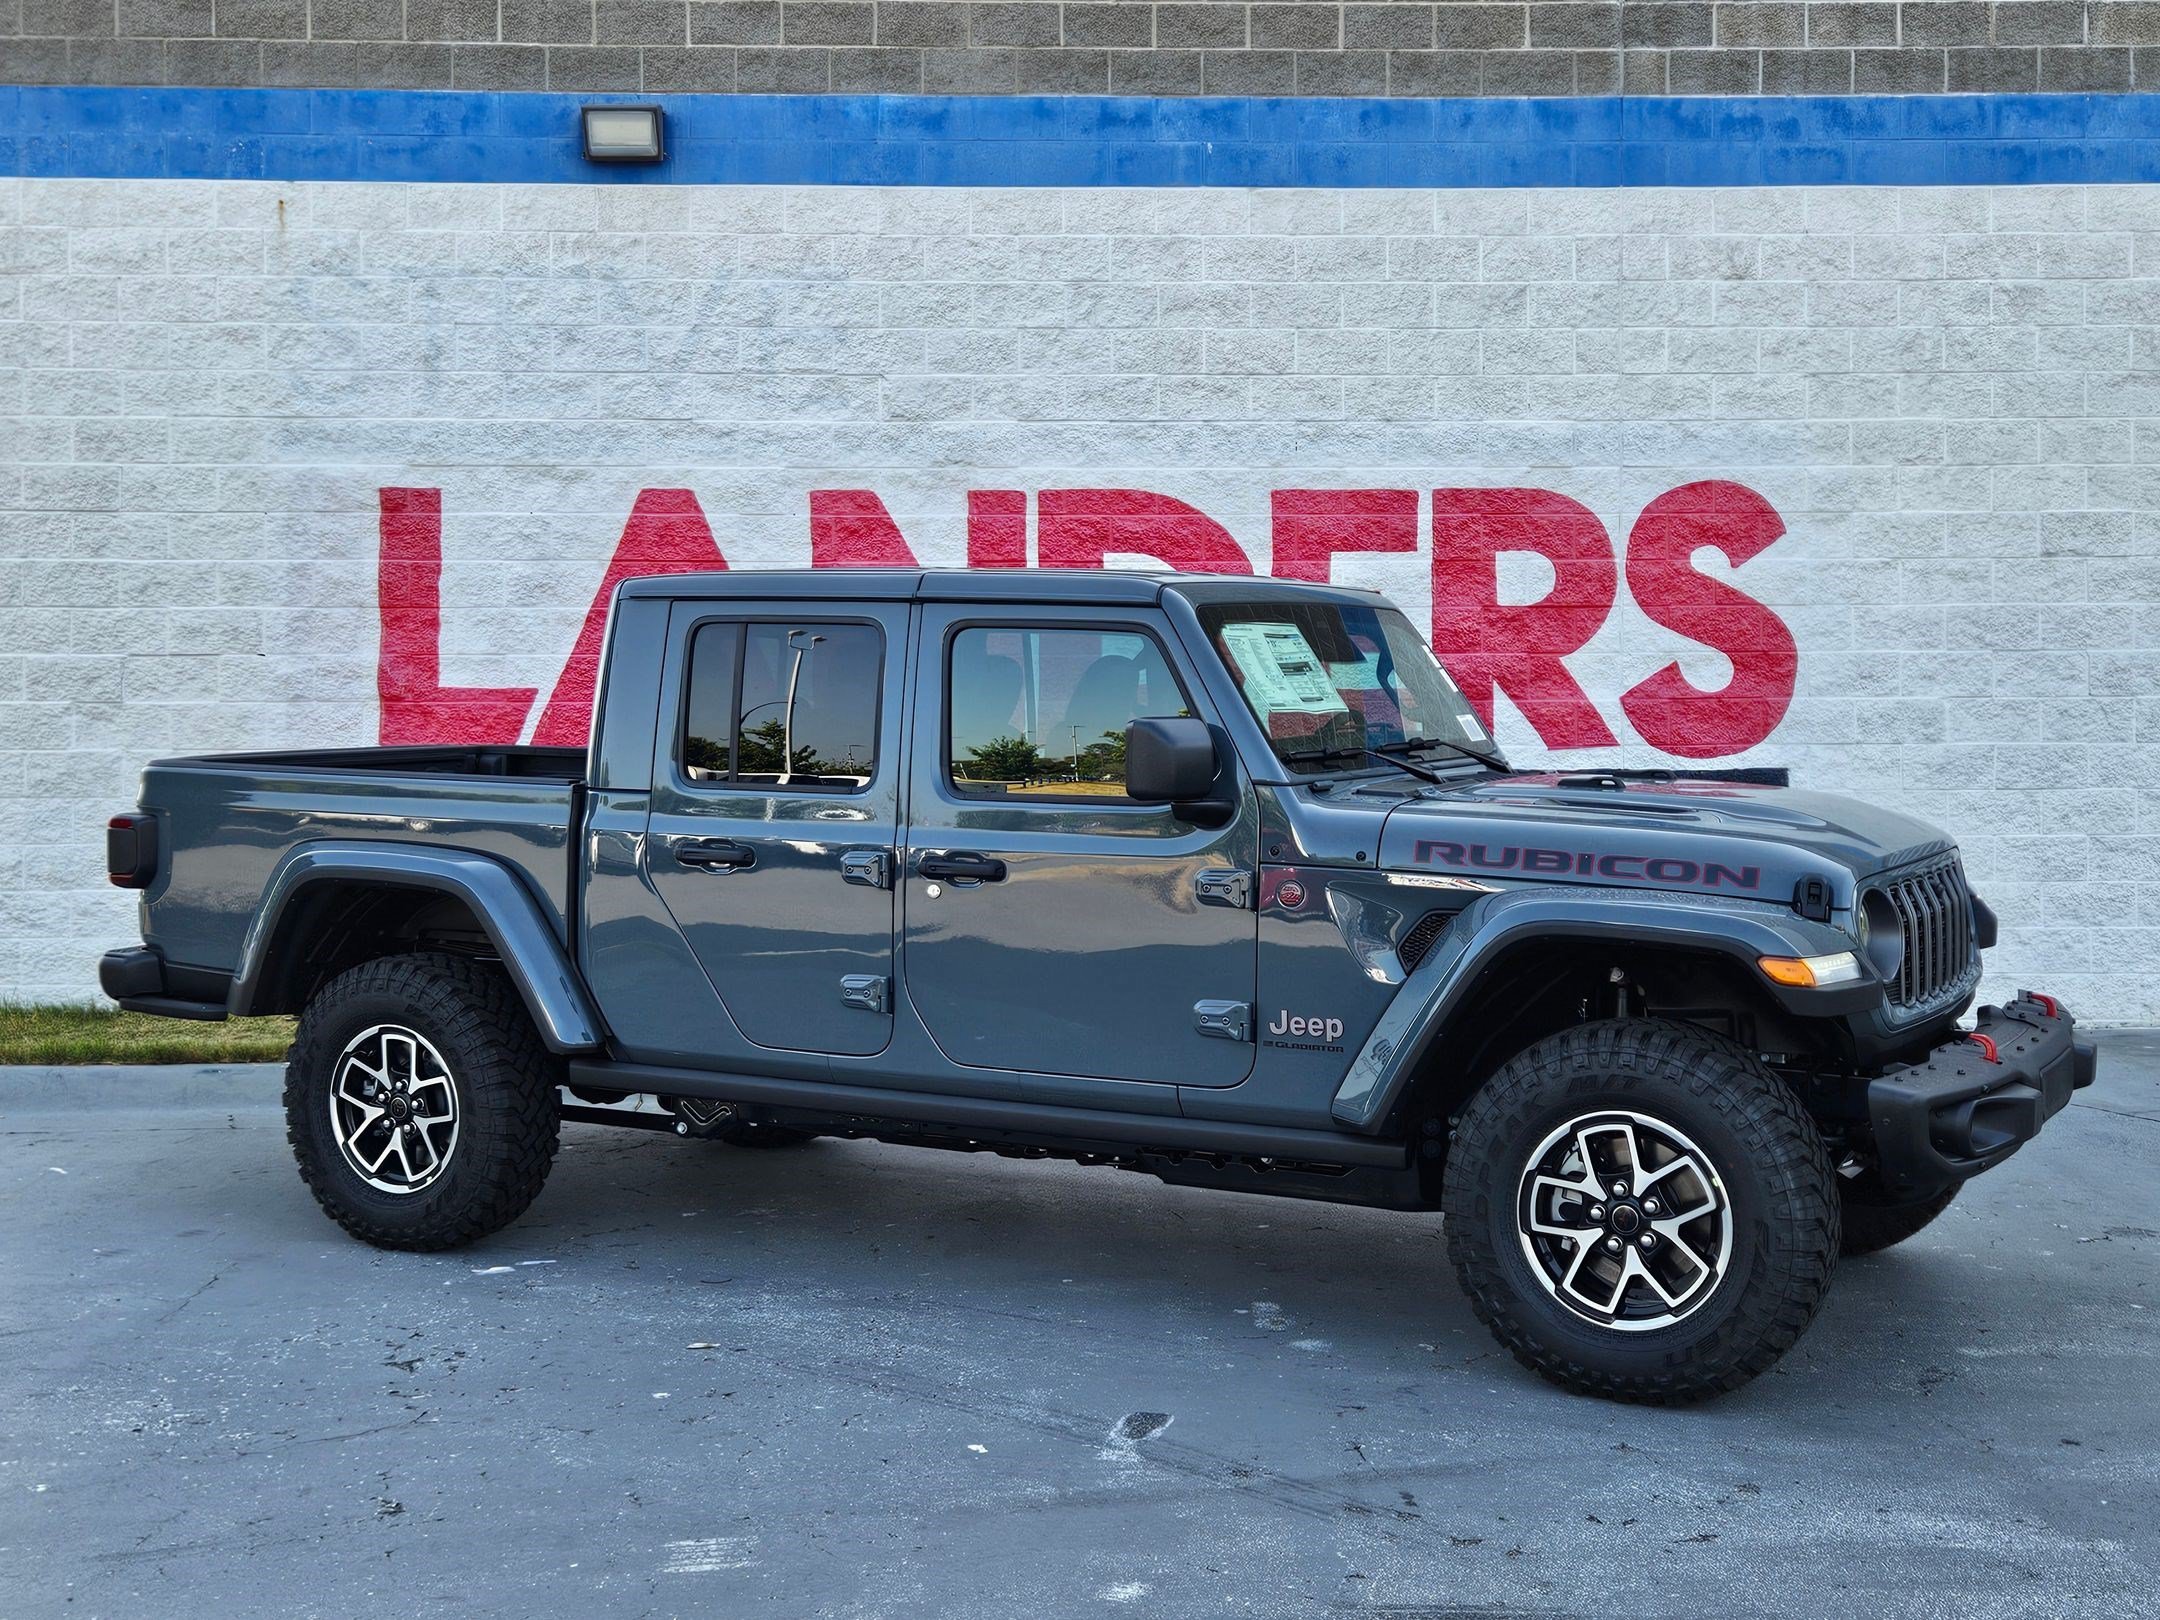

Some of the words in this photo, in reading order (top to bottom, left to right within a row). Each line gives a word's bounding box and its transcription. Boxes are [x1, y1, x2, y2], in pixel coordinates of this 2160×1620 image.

[1414, 840, 1761, 890] RUBICON
[1269, 1009, 1344, 1042] Jeep
[1275, 1041, 1344, 1053] GLADIATOR
